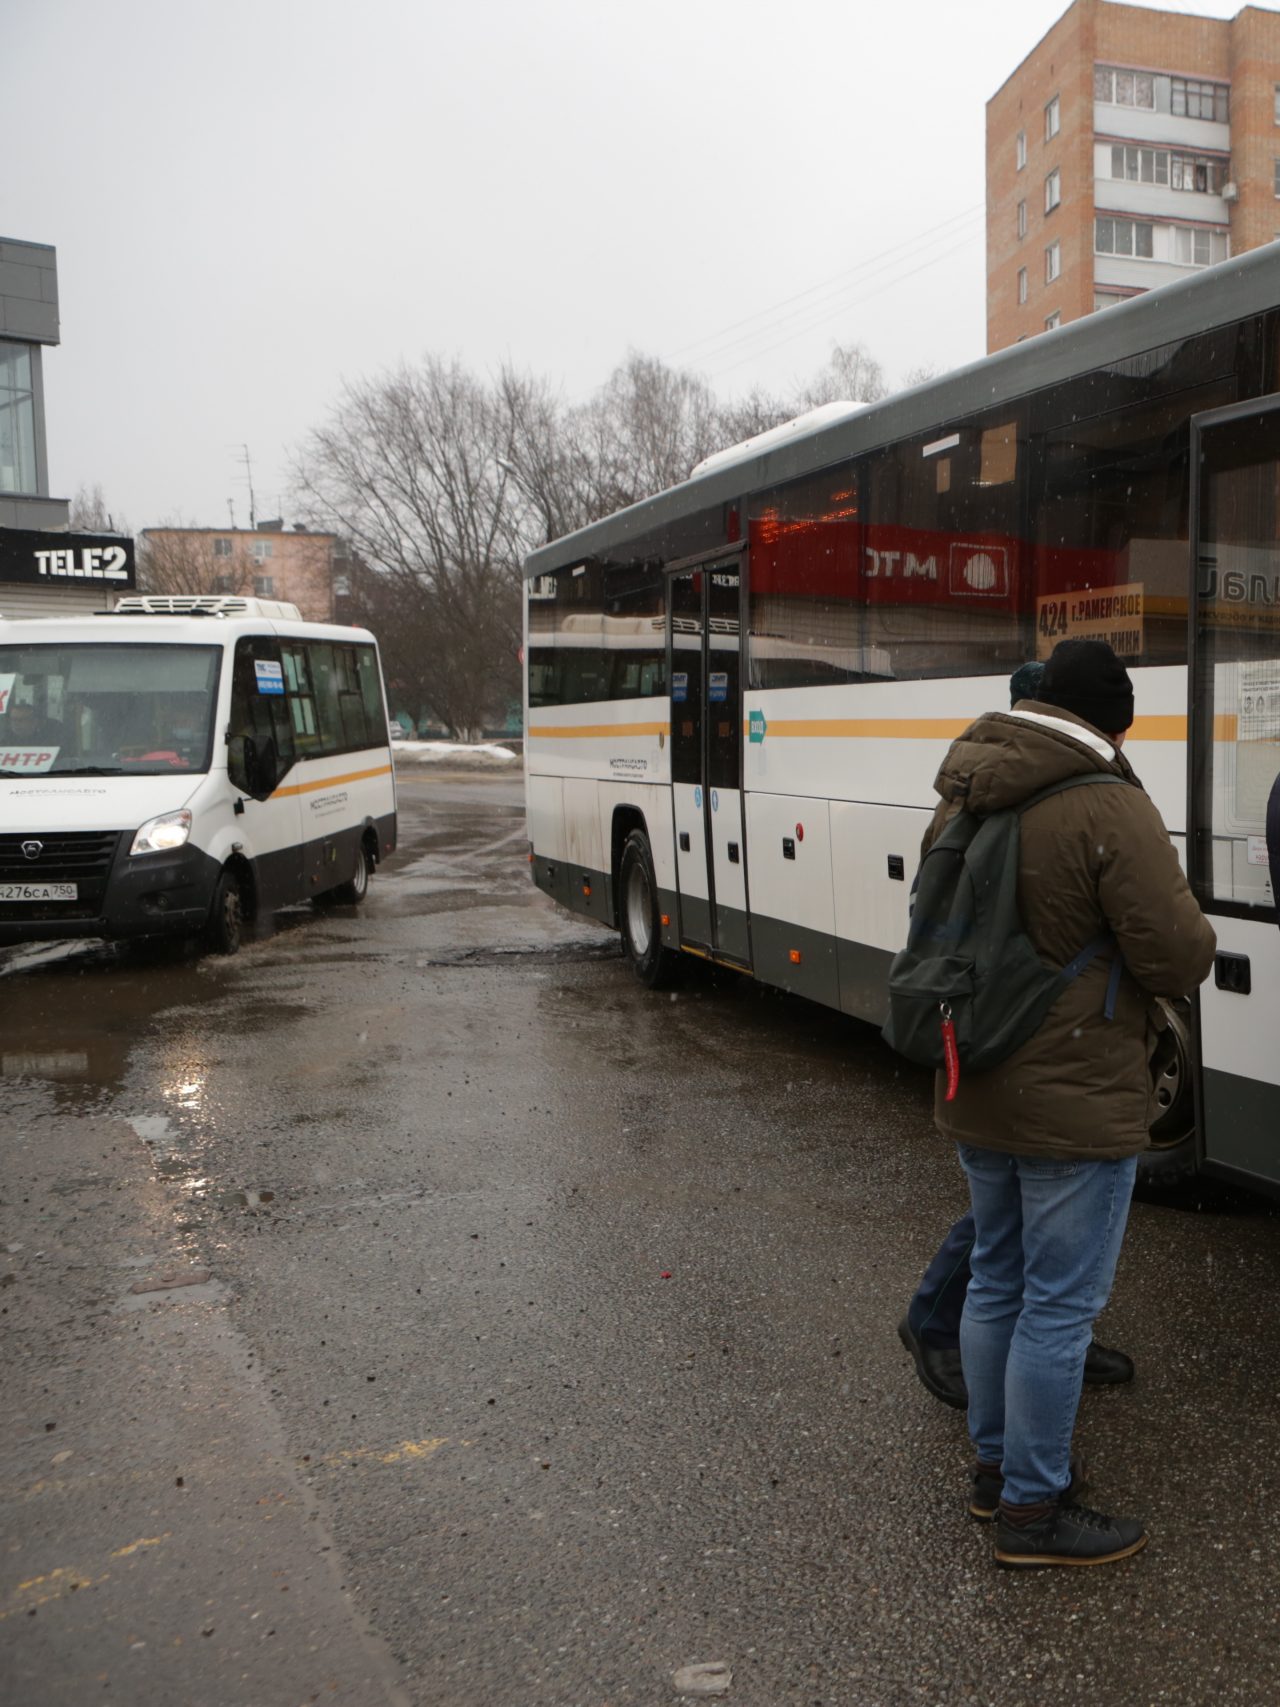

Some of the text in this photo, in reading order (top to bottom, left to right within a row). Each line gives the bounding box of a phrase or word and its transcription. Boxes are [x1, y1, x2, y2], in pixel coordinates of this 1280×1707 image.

[33, 546, 128, 579] TELE2
[1039, 594, 1140, 637] 424 г.РАМЕНСКОЕ
[0, 752, 51, 766] НТР
[53, 885, 73, 895] 750
